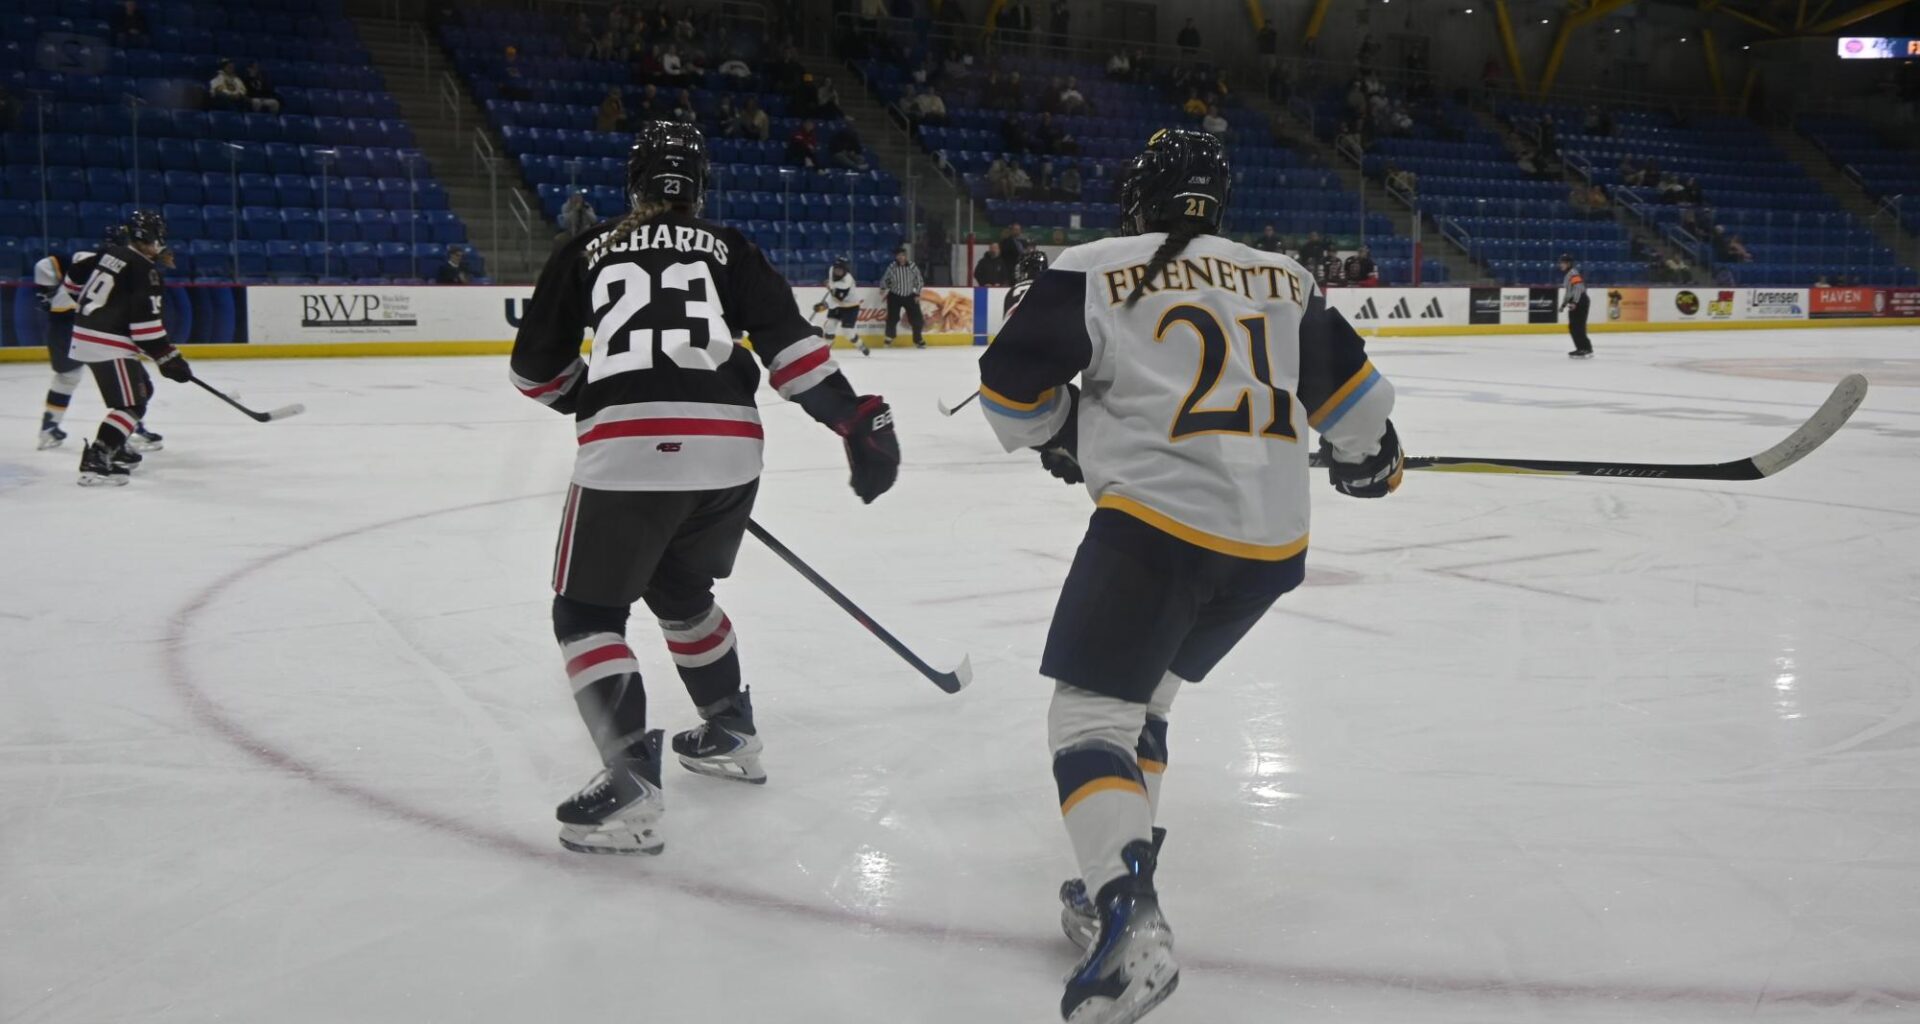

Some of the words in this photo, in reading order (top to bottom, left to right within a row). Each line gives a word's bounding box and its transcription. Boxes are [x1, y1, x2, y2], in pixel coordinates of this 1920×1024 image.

[663, 179, 681, 195] 23
[1184, 198, 1206, 217] 21
[586, 223, 729, 271] RICHARDS
[75, 268, 116, 316] 19
[1103, 255, 1304, 306] FRENETTE
[1820, 290, 1861, 303] HAVEN
[300, 294, 381, 320] BWP
[586, 260, 735, 385] 23
[1154, 302, 1298, 443] 21
